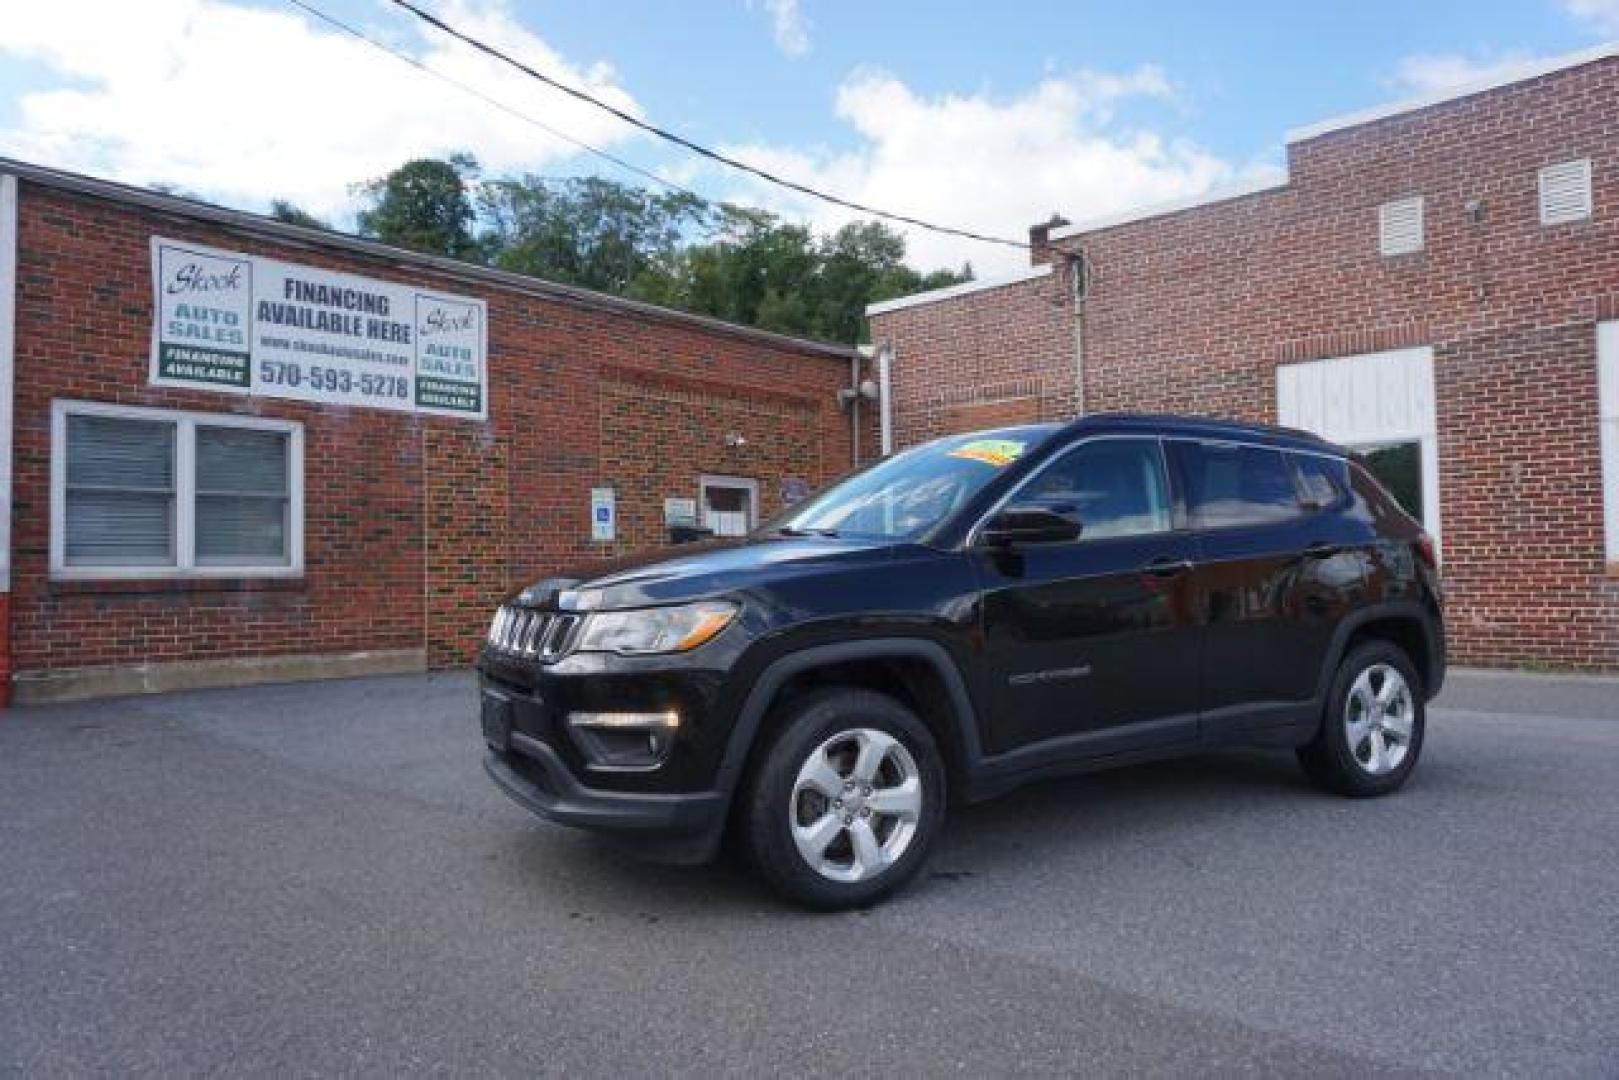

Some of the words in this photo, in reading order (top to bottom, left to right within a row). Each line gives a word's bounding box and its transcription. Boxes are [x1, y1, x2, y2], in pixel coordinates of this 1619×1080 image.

[284, 277, 390, 317] FINANCING
[174, 303, 239, 327] AUTO
[257, 300, 362, 338] AVAILABLE
[366, 320, 411, 345] HERE
[168, 320, 244, 345] SALES
[425, 343, 472, 361] AUTO
[259, 360, 408, 398] 570-593-5278
